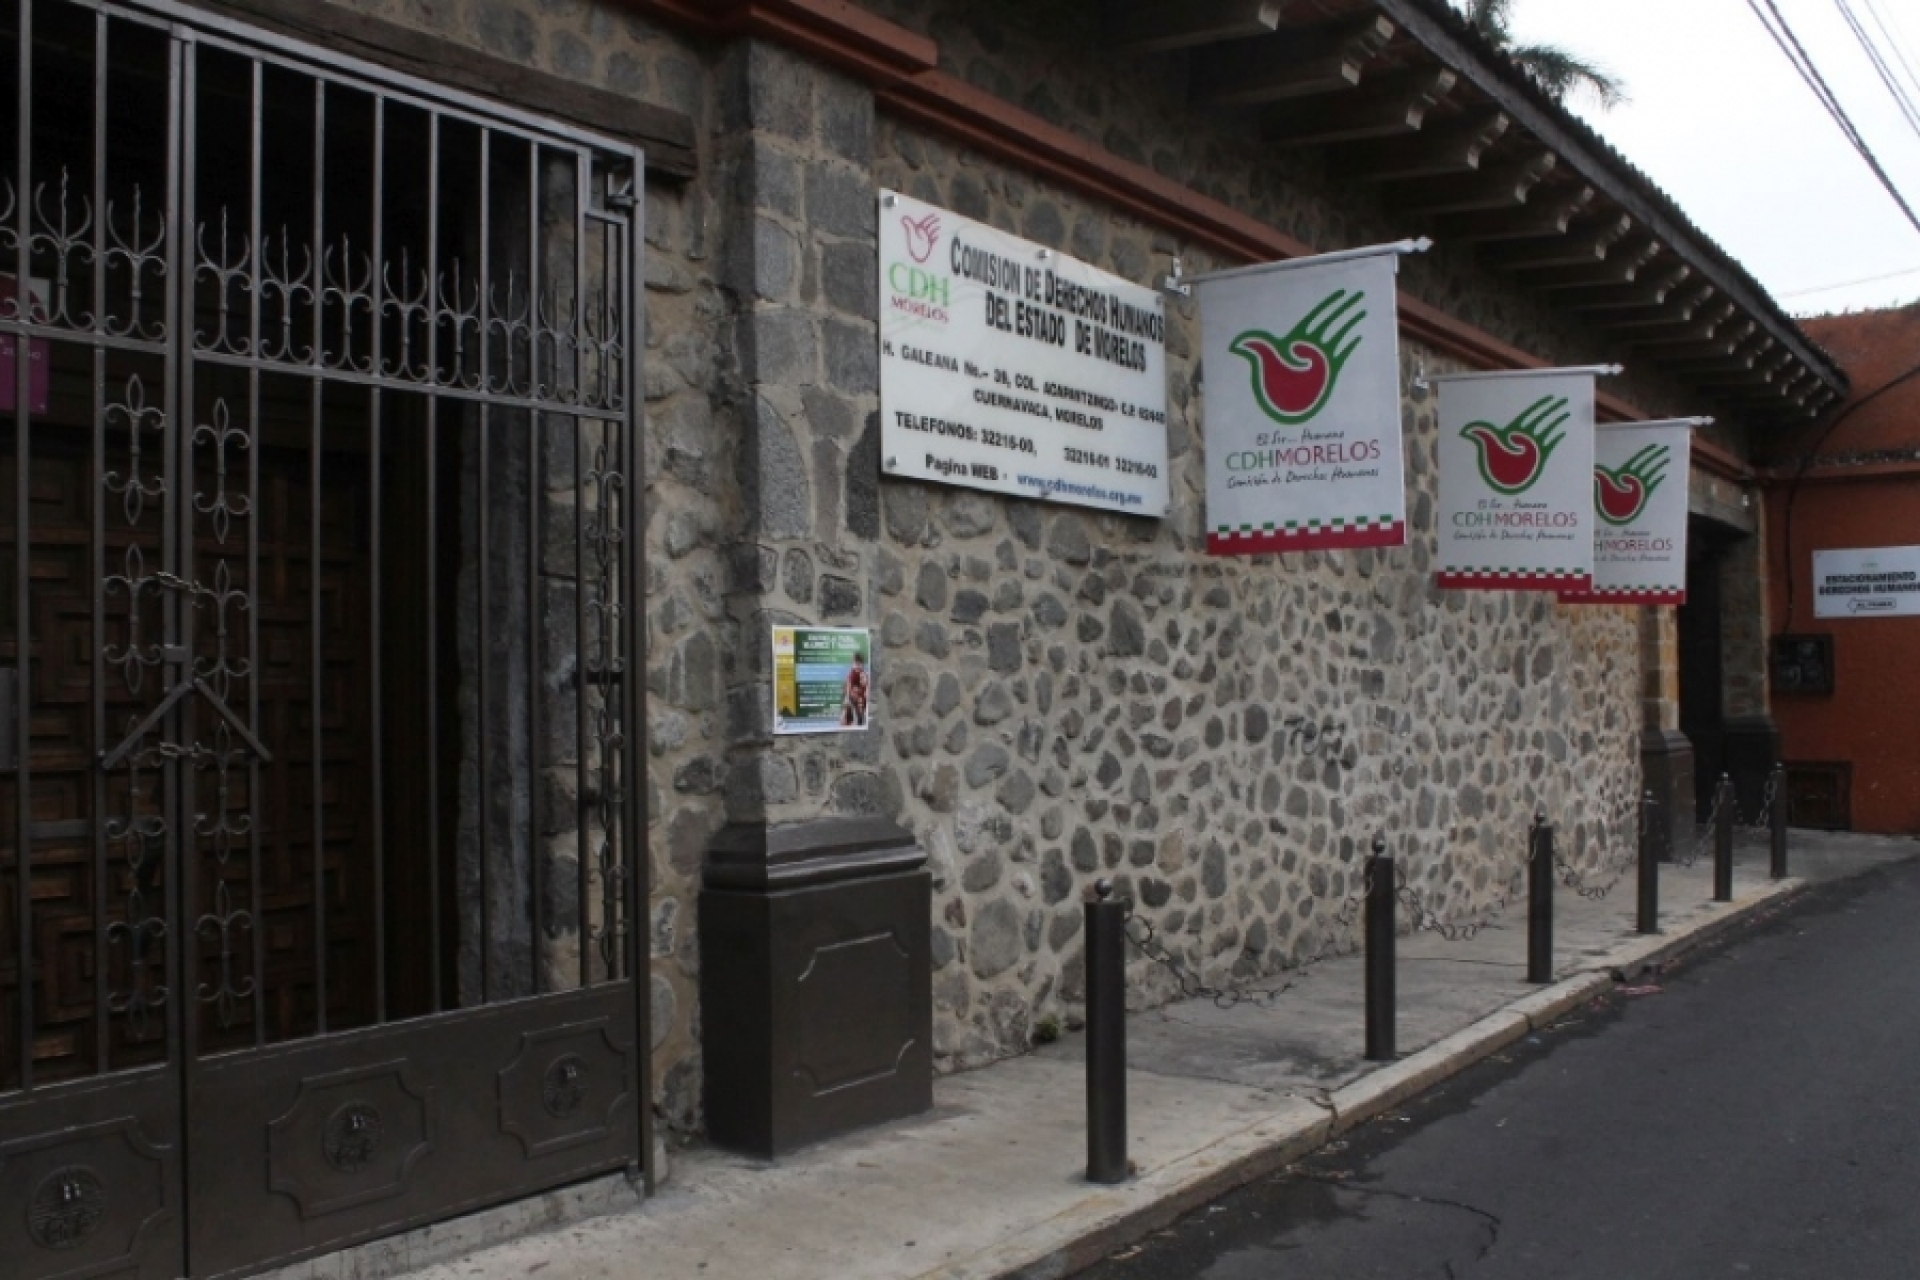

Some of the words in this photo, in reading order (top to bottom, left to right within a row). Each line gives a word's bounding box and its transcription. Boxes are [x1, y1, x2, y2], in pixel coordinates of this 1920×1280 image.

[889, 261, 949, 308] CDH
[891, 295, 949, 323] MORELOS
[1024, 266, 1042, 303] DE
[1044, 269, 1108, 326] DERECHOS
[1108, 293, 1164, 344] HUMANOS
[985, 290, 1012, 333] DEL
[1015, 299, 1066, 348] ESTADO
[1075, 319, 1092, 356] DE
[1093, 325, 1147, 373] MORELOS
[901, 343, 958, 373] GALEANA
[1015, 372, 1040, 393] COL.
[894, 411, 979, 441] TELEFONOS:
[973, 388, 1053, 423] CUERNAVACA,
[1055, 406, 1104, 432] MORELOS
[1301, 428, 1345, 443] Humano
[925, 453, 969, 477] Pagina
[970, 463, 999, 481] WEB
[1225, 439, 1381, 471] CDHMORELOS
[1285, 467, 1328, 484] Derechos
[1330, 466, 1379, 482] Humanos
